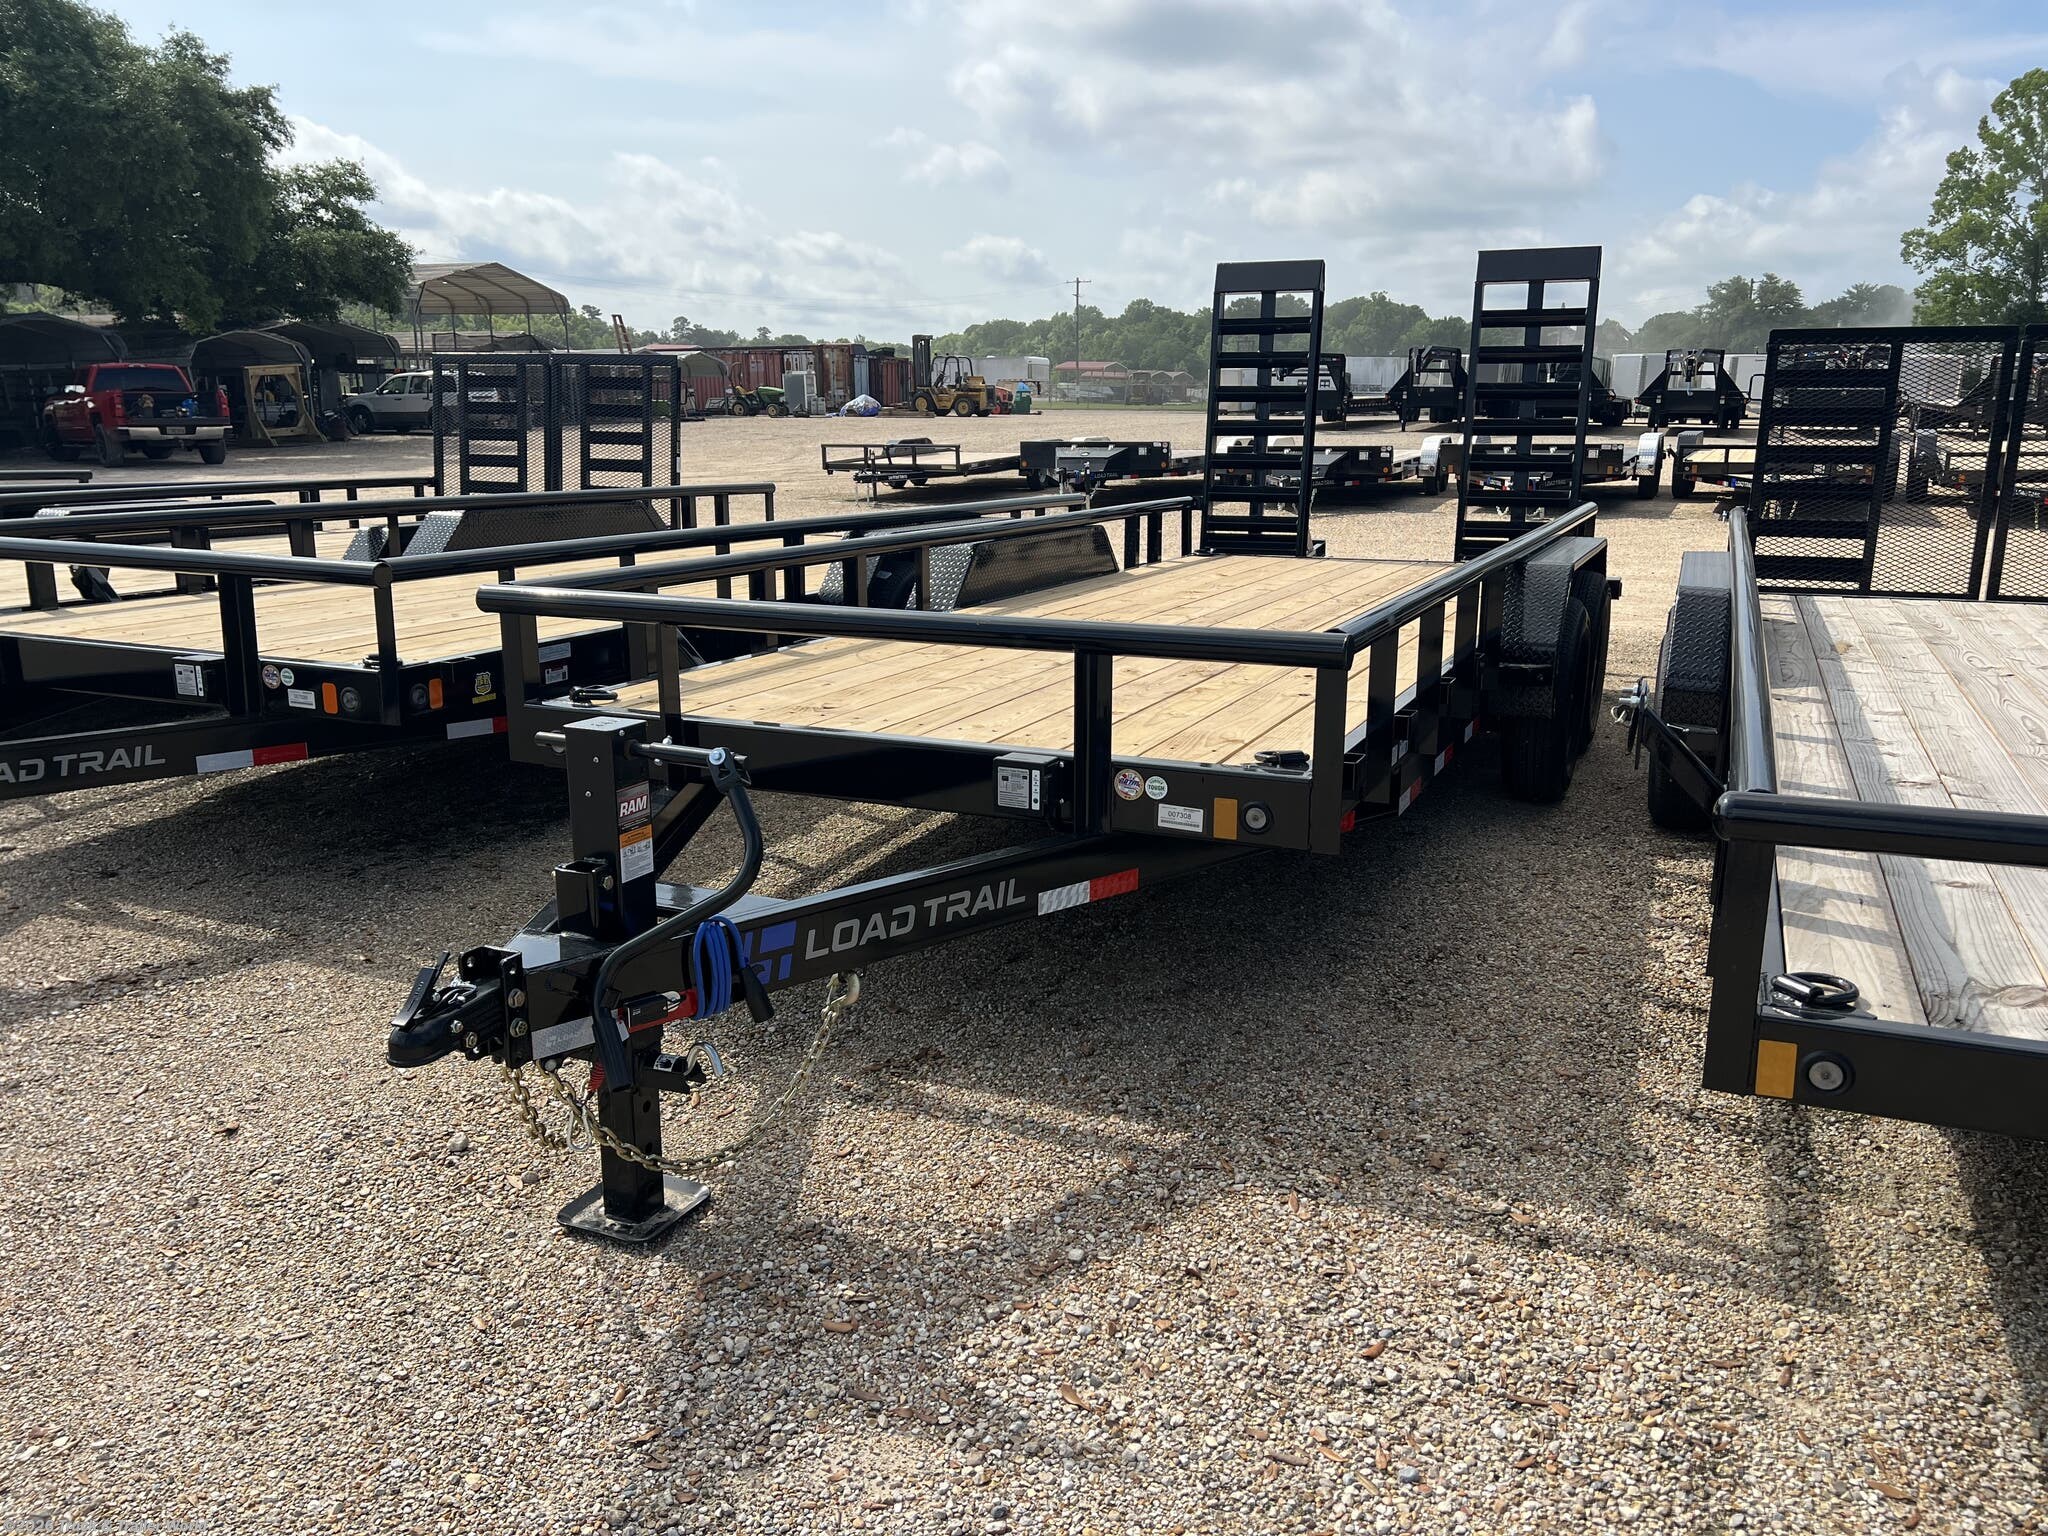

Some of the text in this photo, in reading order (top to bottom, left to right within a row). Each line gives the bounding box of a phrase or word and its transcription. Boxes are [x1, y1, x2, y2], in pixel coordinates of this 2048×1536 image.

[53, 745, 166, 777] TRAIL
[619, 795, 648, 818] RAM
[1167, 810, 1192, 820] 007308
[805, 878, 1026, 960] LOAD TRAIL
